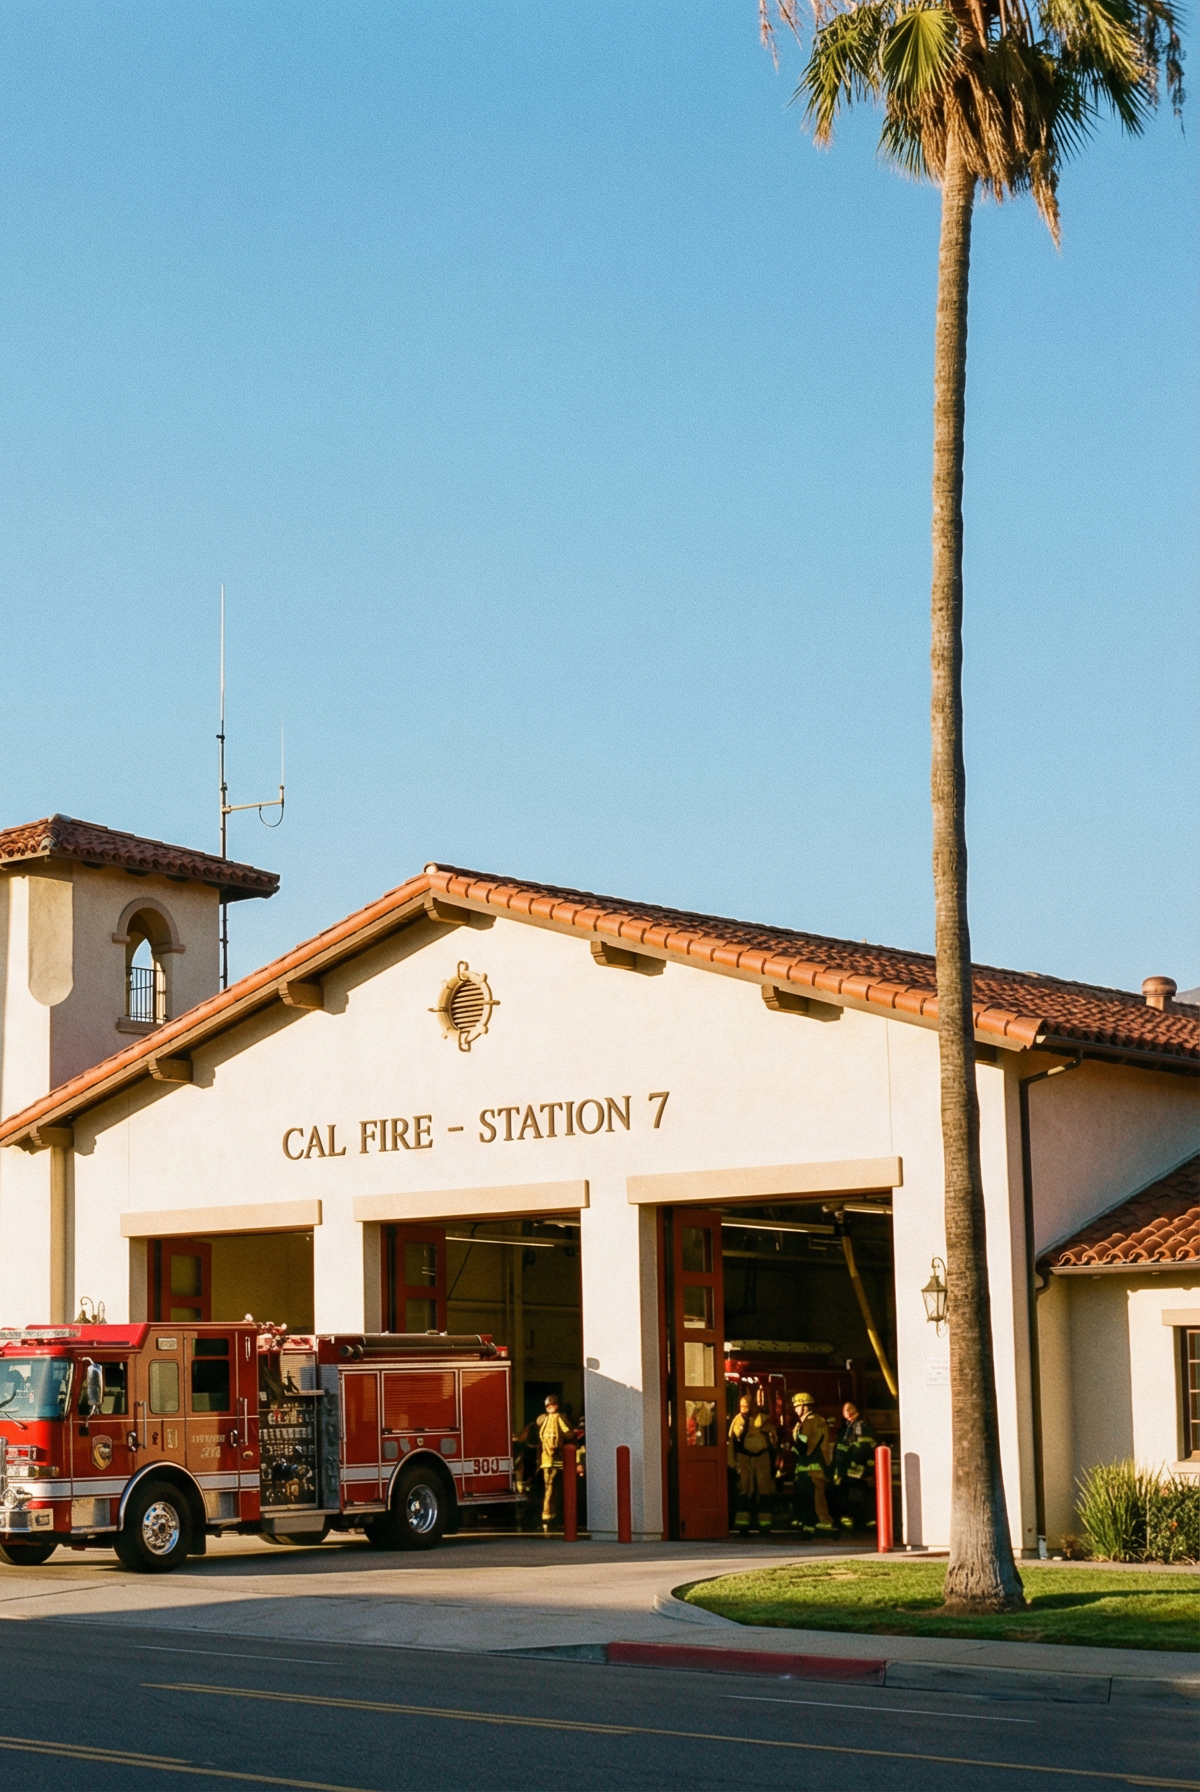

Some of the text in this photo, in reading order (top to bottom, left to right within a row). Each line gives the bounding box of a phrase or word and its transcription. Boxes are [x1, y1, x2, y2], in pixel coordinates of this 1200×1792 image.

[282, 1124, 347, 1161] CAL
[359, 1114, 434, 1155] FIRE
[479, 1095, 632, 1144] STATION
[648, 1091, 670, 1129] 7
